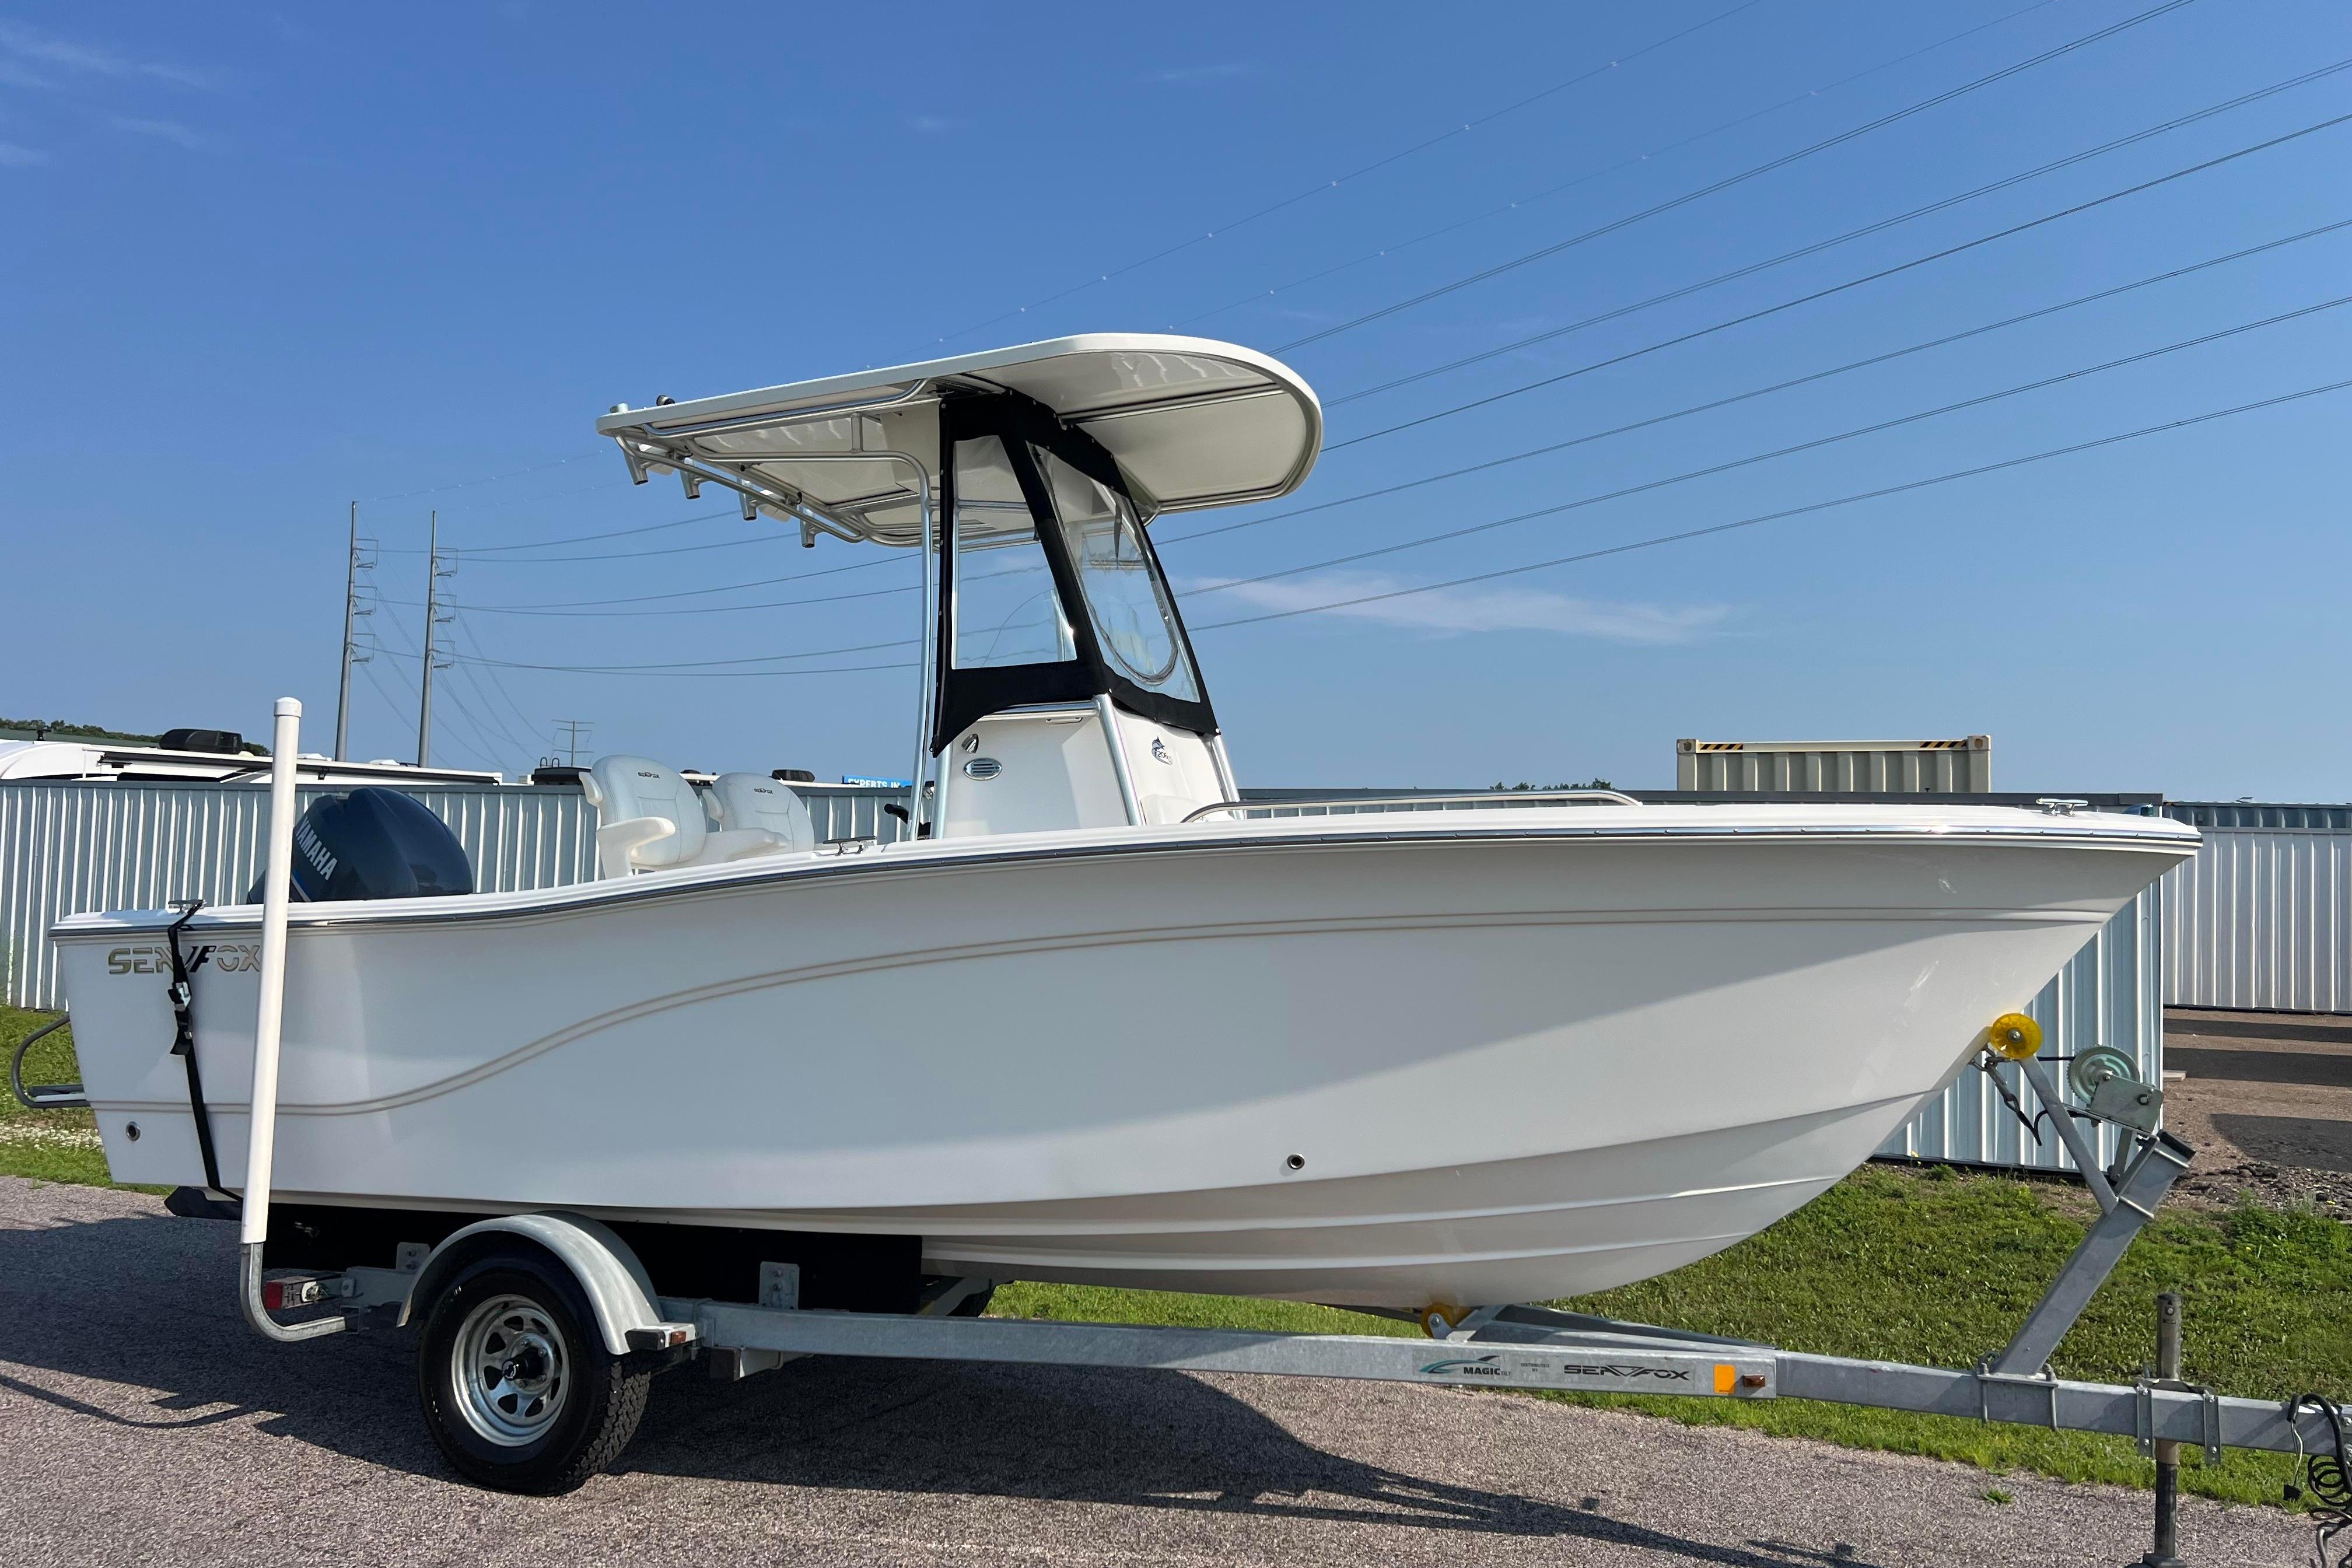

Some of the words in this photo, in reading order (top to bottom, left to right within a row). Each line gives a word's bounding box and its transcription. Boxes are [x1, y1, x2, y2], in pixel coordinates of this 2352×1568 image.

[848, 778, 887, 788] EXPERTS
[296, 816, 338, 881] YAMAHA
[1463, 1366, 1501, 1376] MAGIC
